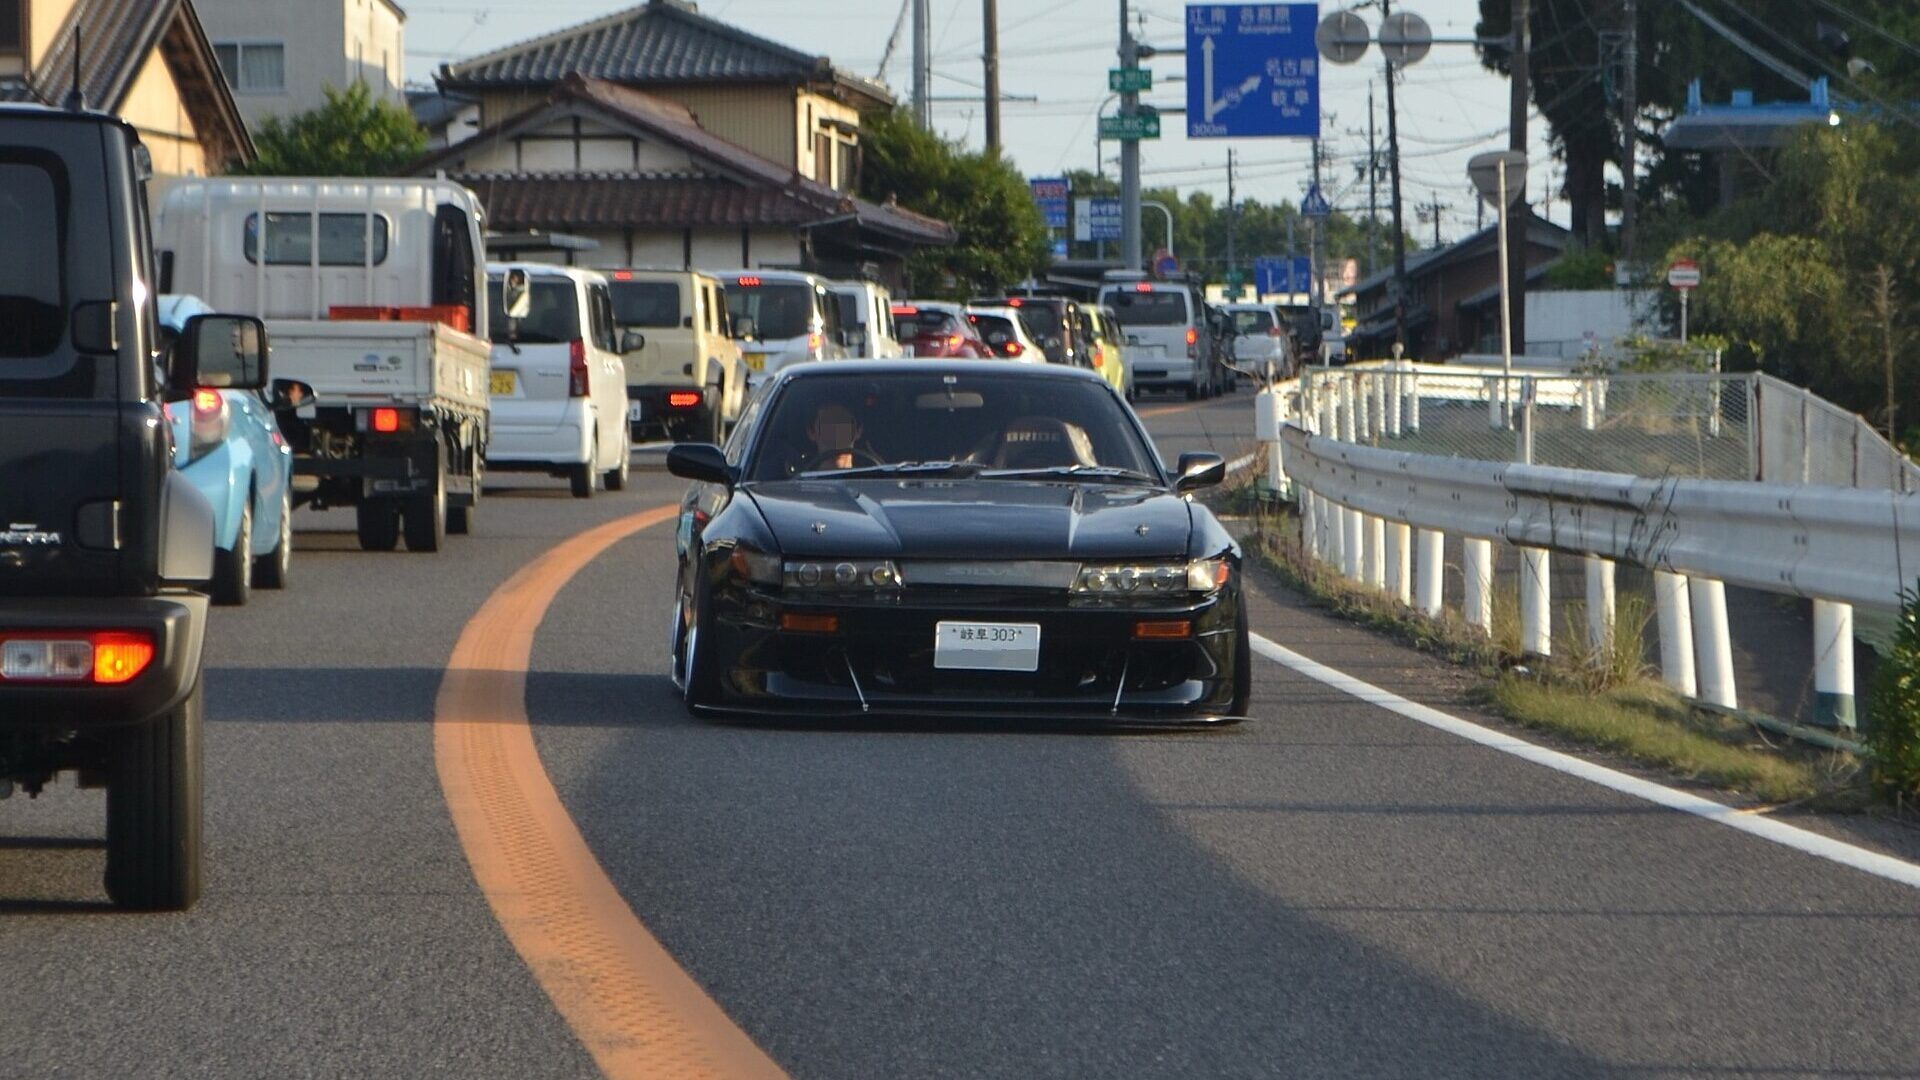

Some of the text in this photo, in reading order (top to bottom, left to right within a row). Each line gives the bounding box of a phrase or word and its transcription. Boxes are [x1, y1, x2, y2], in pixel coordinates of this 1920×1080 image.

[1266, 59, 1315, 76] 名古屋
[1271, 89, 1309, 106] 岐阜
[1192, 124, 1227, 136] 300m
[1006, 431, 1060, 442] BRIDE
[960, 628, 1016, 641] 岐阜 303
